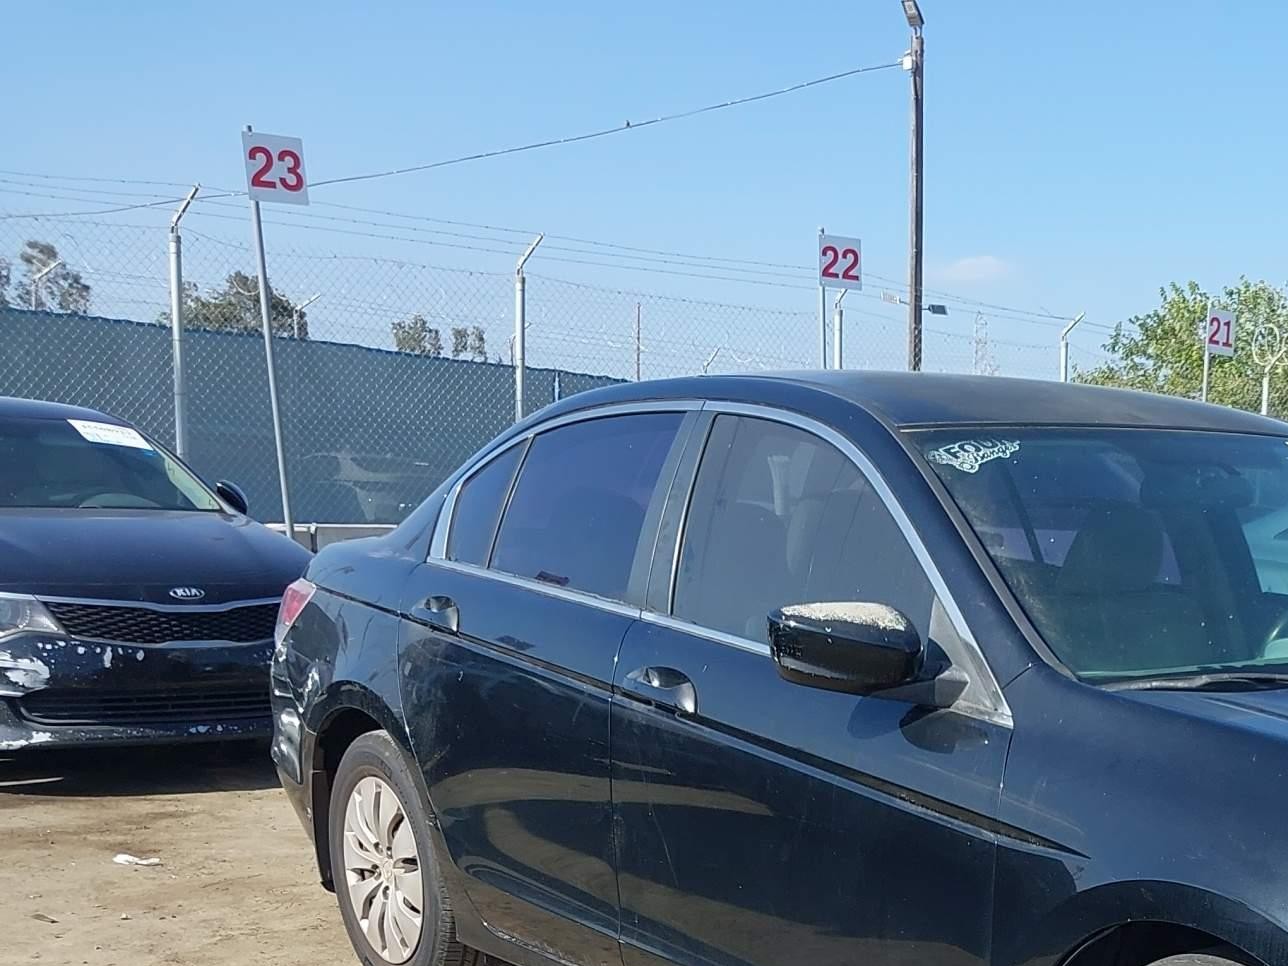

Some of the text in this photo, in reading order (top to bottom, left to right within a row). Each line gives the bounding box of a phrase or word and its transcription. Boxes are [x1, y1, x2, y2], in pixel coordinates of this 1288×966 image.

[248, 146, 304, 193] 23
[821, 245, 860, 282] 22
[1208, 316, 1233, 349] 21
